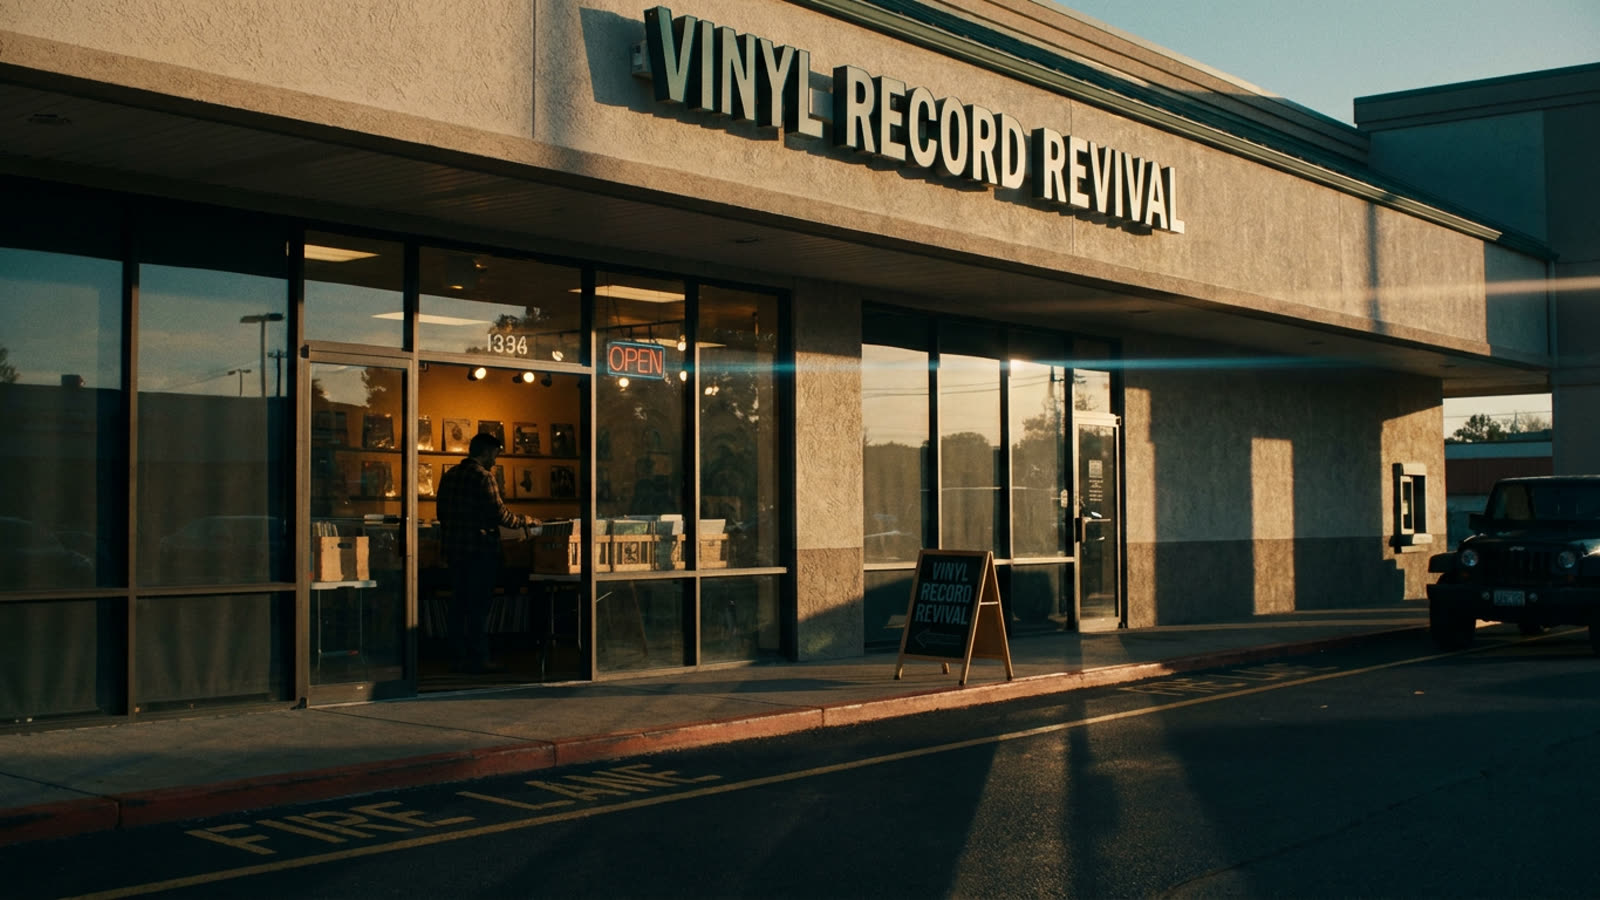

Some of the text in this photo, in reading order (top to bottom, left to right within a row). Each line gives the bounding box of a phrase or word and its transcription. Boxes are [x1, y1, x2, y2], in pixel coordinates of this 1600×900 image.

[648, 6, 1186, 234] VINYL RECORD REVIVAL
[609, 345, 663, 374] OPEN
[932, 560, 969, 582] VINYL
[920, 582, 973, 603] RECORD
[914, 603, 969, 625] REVIVAL
[185, 800, 475, 855] FIRE
